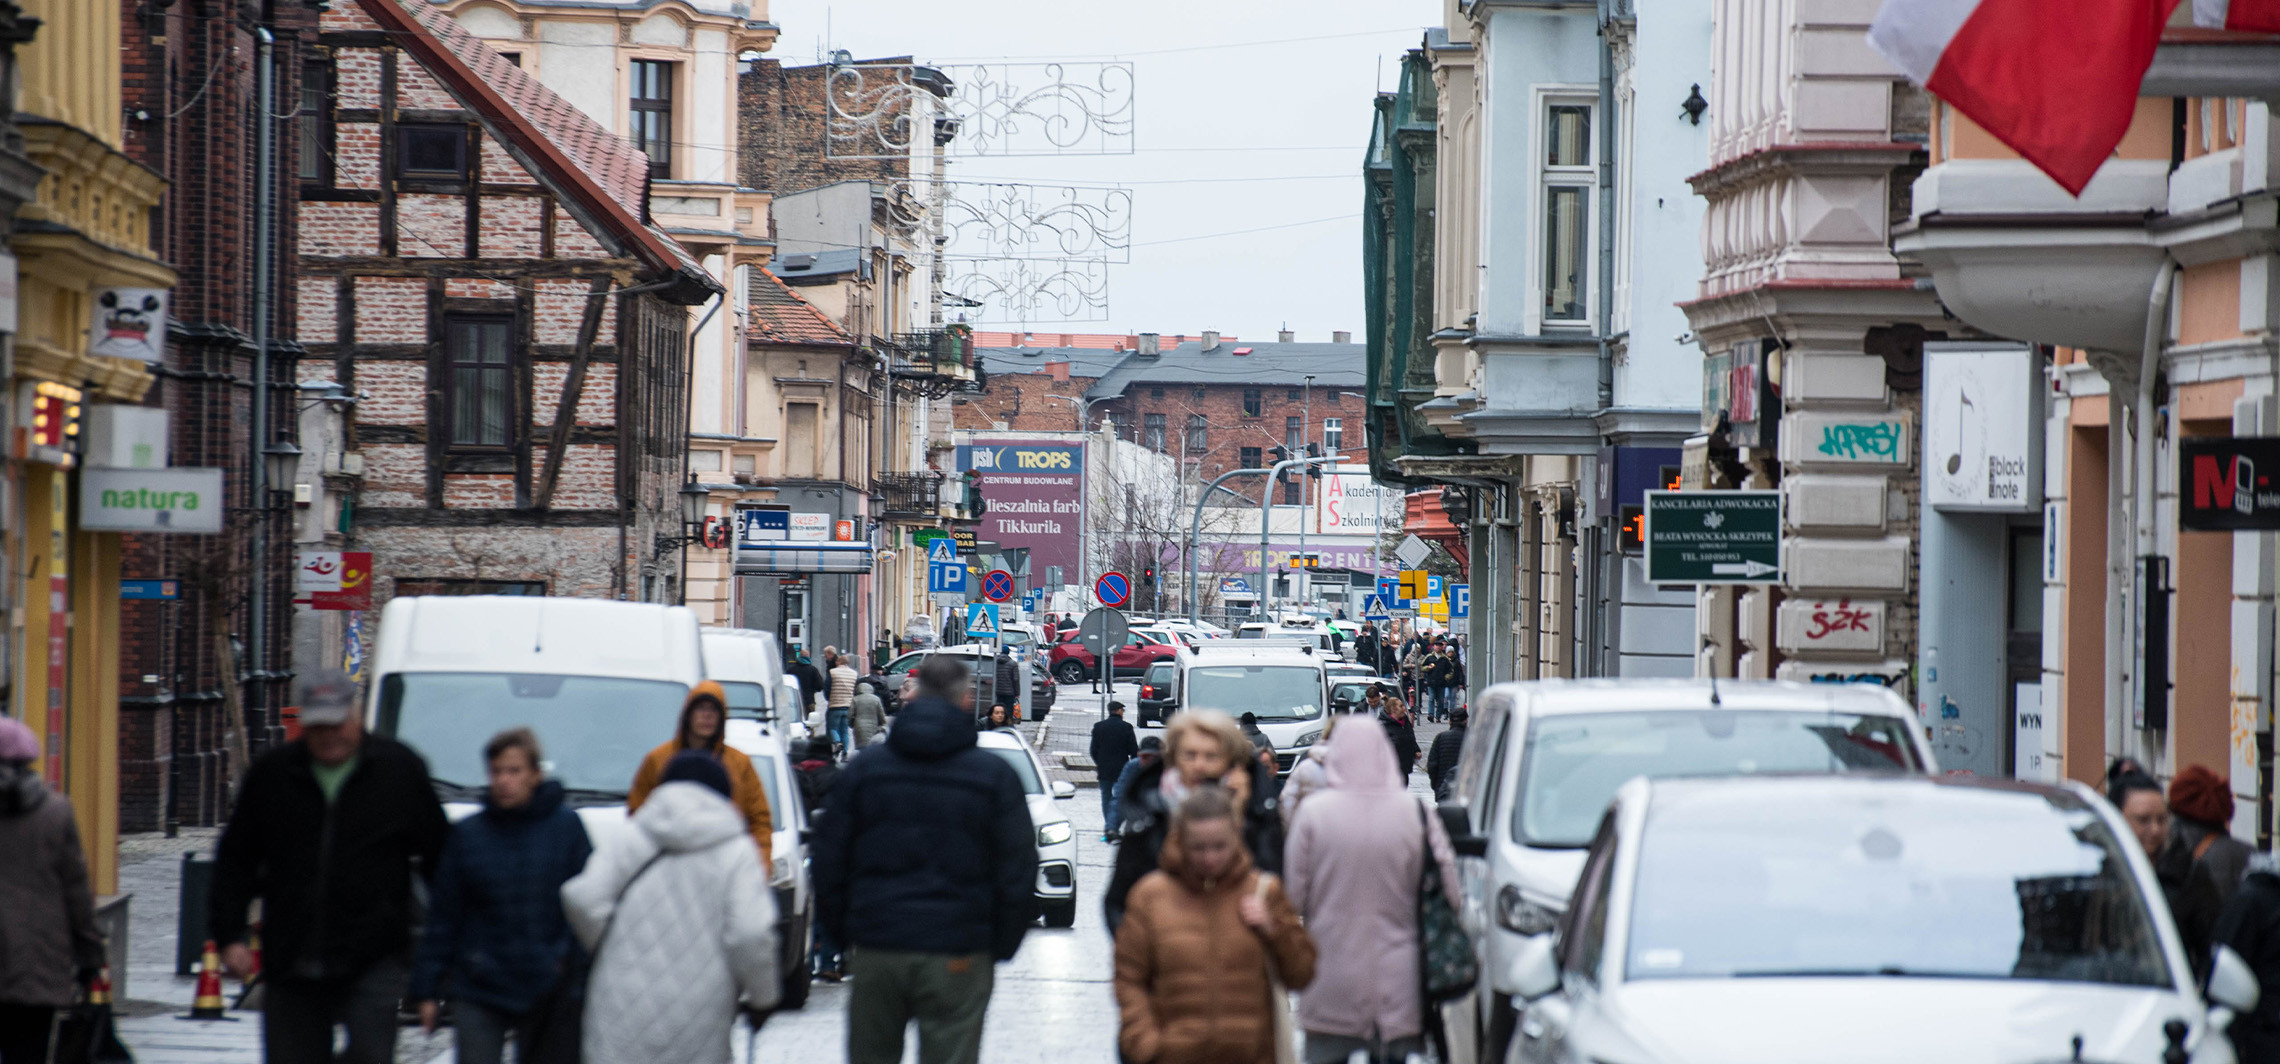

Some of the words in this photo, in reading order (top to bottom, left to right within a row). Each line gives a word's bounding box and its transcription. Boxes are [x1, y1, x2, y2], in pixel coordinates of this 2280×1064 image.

[972, 447, 993, 469] psb
[1016, 451, 1071, 469] TROPS
[1996, 455, 2025, 476] black
[983, 476, 1022, 485] CENTRUM
[1024, 477, 1074, 485] BUDOWLANE
[1996, 479, 2019, 499] note
[102, 488, 199, 510] natura
[1053, 499, 1081, 513] farb
[1651, 499, 1712, 509] KANCELARIA
[1714, 499, 1778, 509] ADWOKACKA
[997, 519, 1061, 534] Tikkurila
[954, 532, 973, 540] OOR
[1243, 550, 1290, 568] TROP
[944, 566, 961, 589] P
[1023, 600, 1032, 609] P
